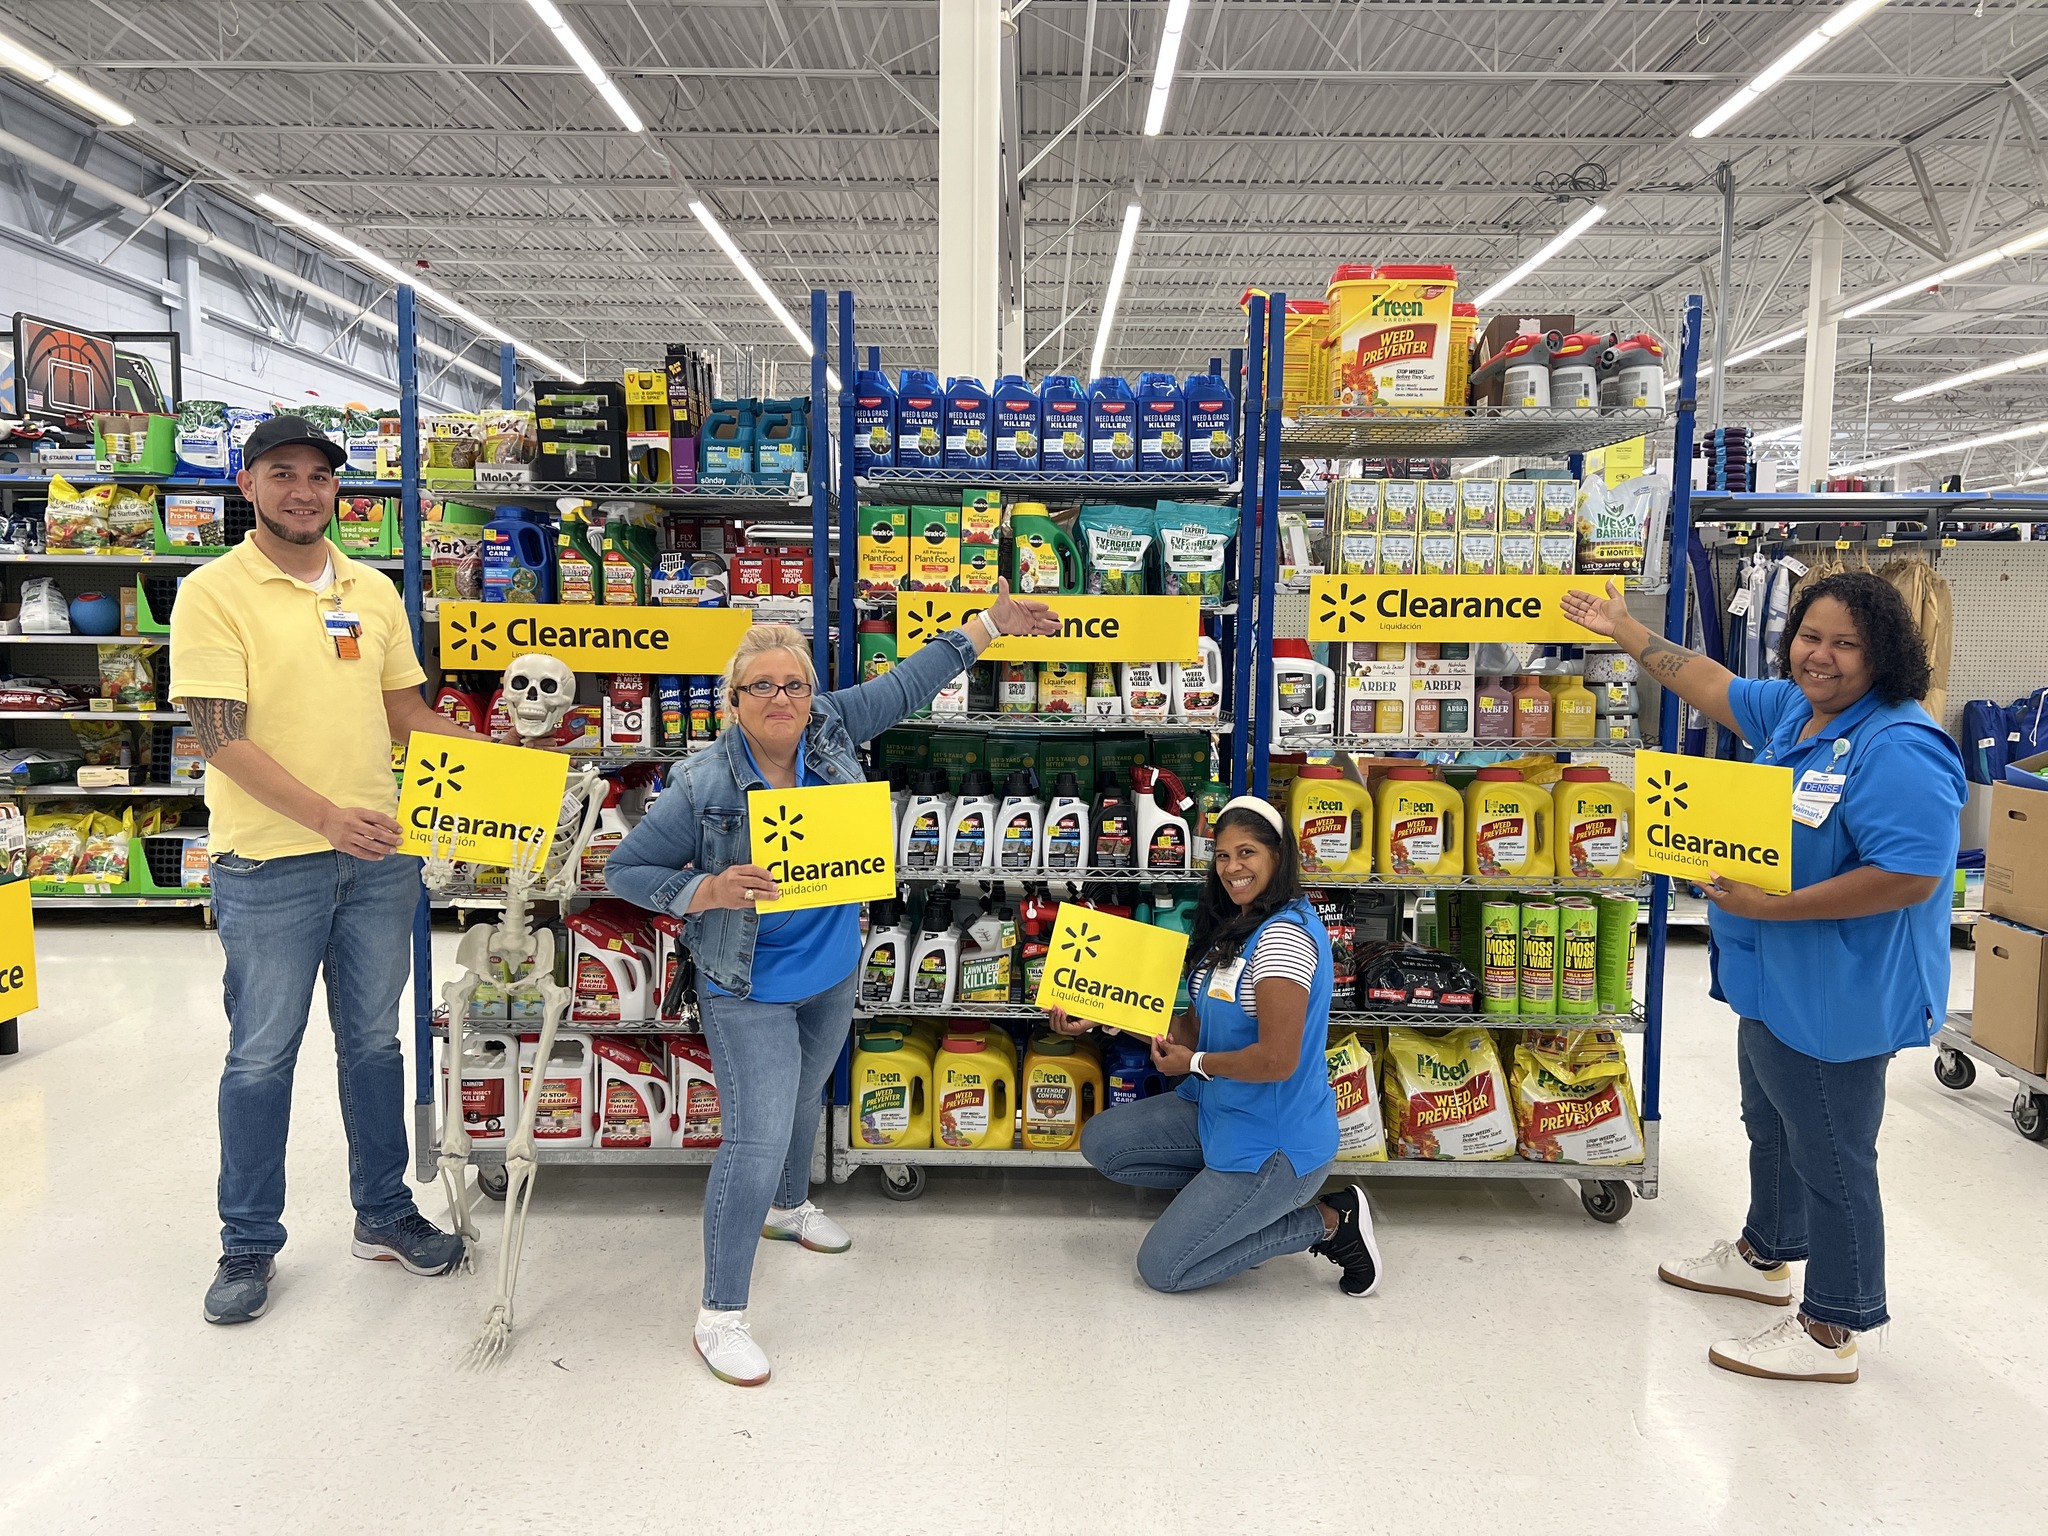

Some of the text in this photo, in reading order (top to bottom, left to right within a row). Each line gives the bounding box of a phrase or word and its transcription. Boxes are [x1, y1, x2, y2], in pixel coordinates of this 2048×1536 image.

[1371, 294, 1423, 317] Preen
[1380, 329, 1414, 347] WEED
[1362, 341, 1428, 367] PREVENTER
[1598, 513, 1636, 529] WEED
[1597, 528, 1636, 538] BARRIER
[1096, 537, 1142, 548] EVERGREEN
[662, 554, 681, 562] HOT
[915, 555, 955, 563] Plant Food
[660, 561, 685, 572] SHOT
[1377, 588, 1541, 618] Clearance
[1380, 622, 1421, 632] Liquidación
[507, 618, 669, 650] Clearance
[614, 682, 643, 690] TRAPS
[1359, 681, 1397, 692] ARBER
[1424, 680, 1461, 690] ARBER
[660, 689, 680, 700] Cutter
[689, 688, 711, 698] Cutter
[1805, 783, 1838, 792] DENISE
[1315, 818, 1334, 827] WEED
[1306, 824, 1342, 836] PREVENTER
[1398, 826, 1433, 838] PREVENTER
[1483, 827, 1518, 838] PREVENTER
[1576, 828, 1612, 840] PREVENTER
[1647, 824, 1780, 866] Clearance
[1648, 847, 1709, 867] Liquidación
[766, 857, 885, 884] Clearance
[778, 883, 827, 897] quidación
[1486, 939, 1516, 955] MOSS
[1523, 941, 1553, 956] MOSS
[1566, 941, 1594, 957] MOSS
[1486, 955, 1515, 967] B WARE
[1523, 956, 1552, 968] B WARE
[1566, 957, 1594, 968] B WARE
[964, 963, 999, 975] LAWN WEED
[1053, 967, 1164, 1013] Clearance
[1051, 988, 1104, 1009] Liquidación
[1417, 1054, 1470, 1080] Preen
[1417, 1094, 1489, 1126] PREVENTER
[1540, 1099, 1612, 1133] PREVENTER
